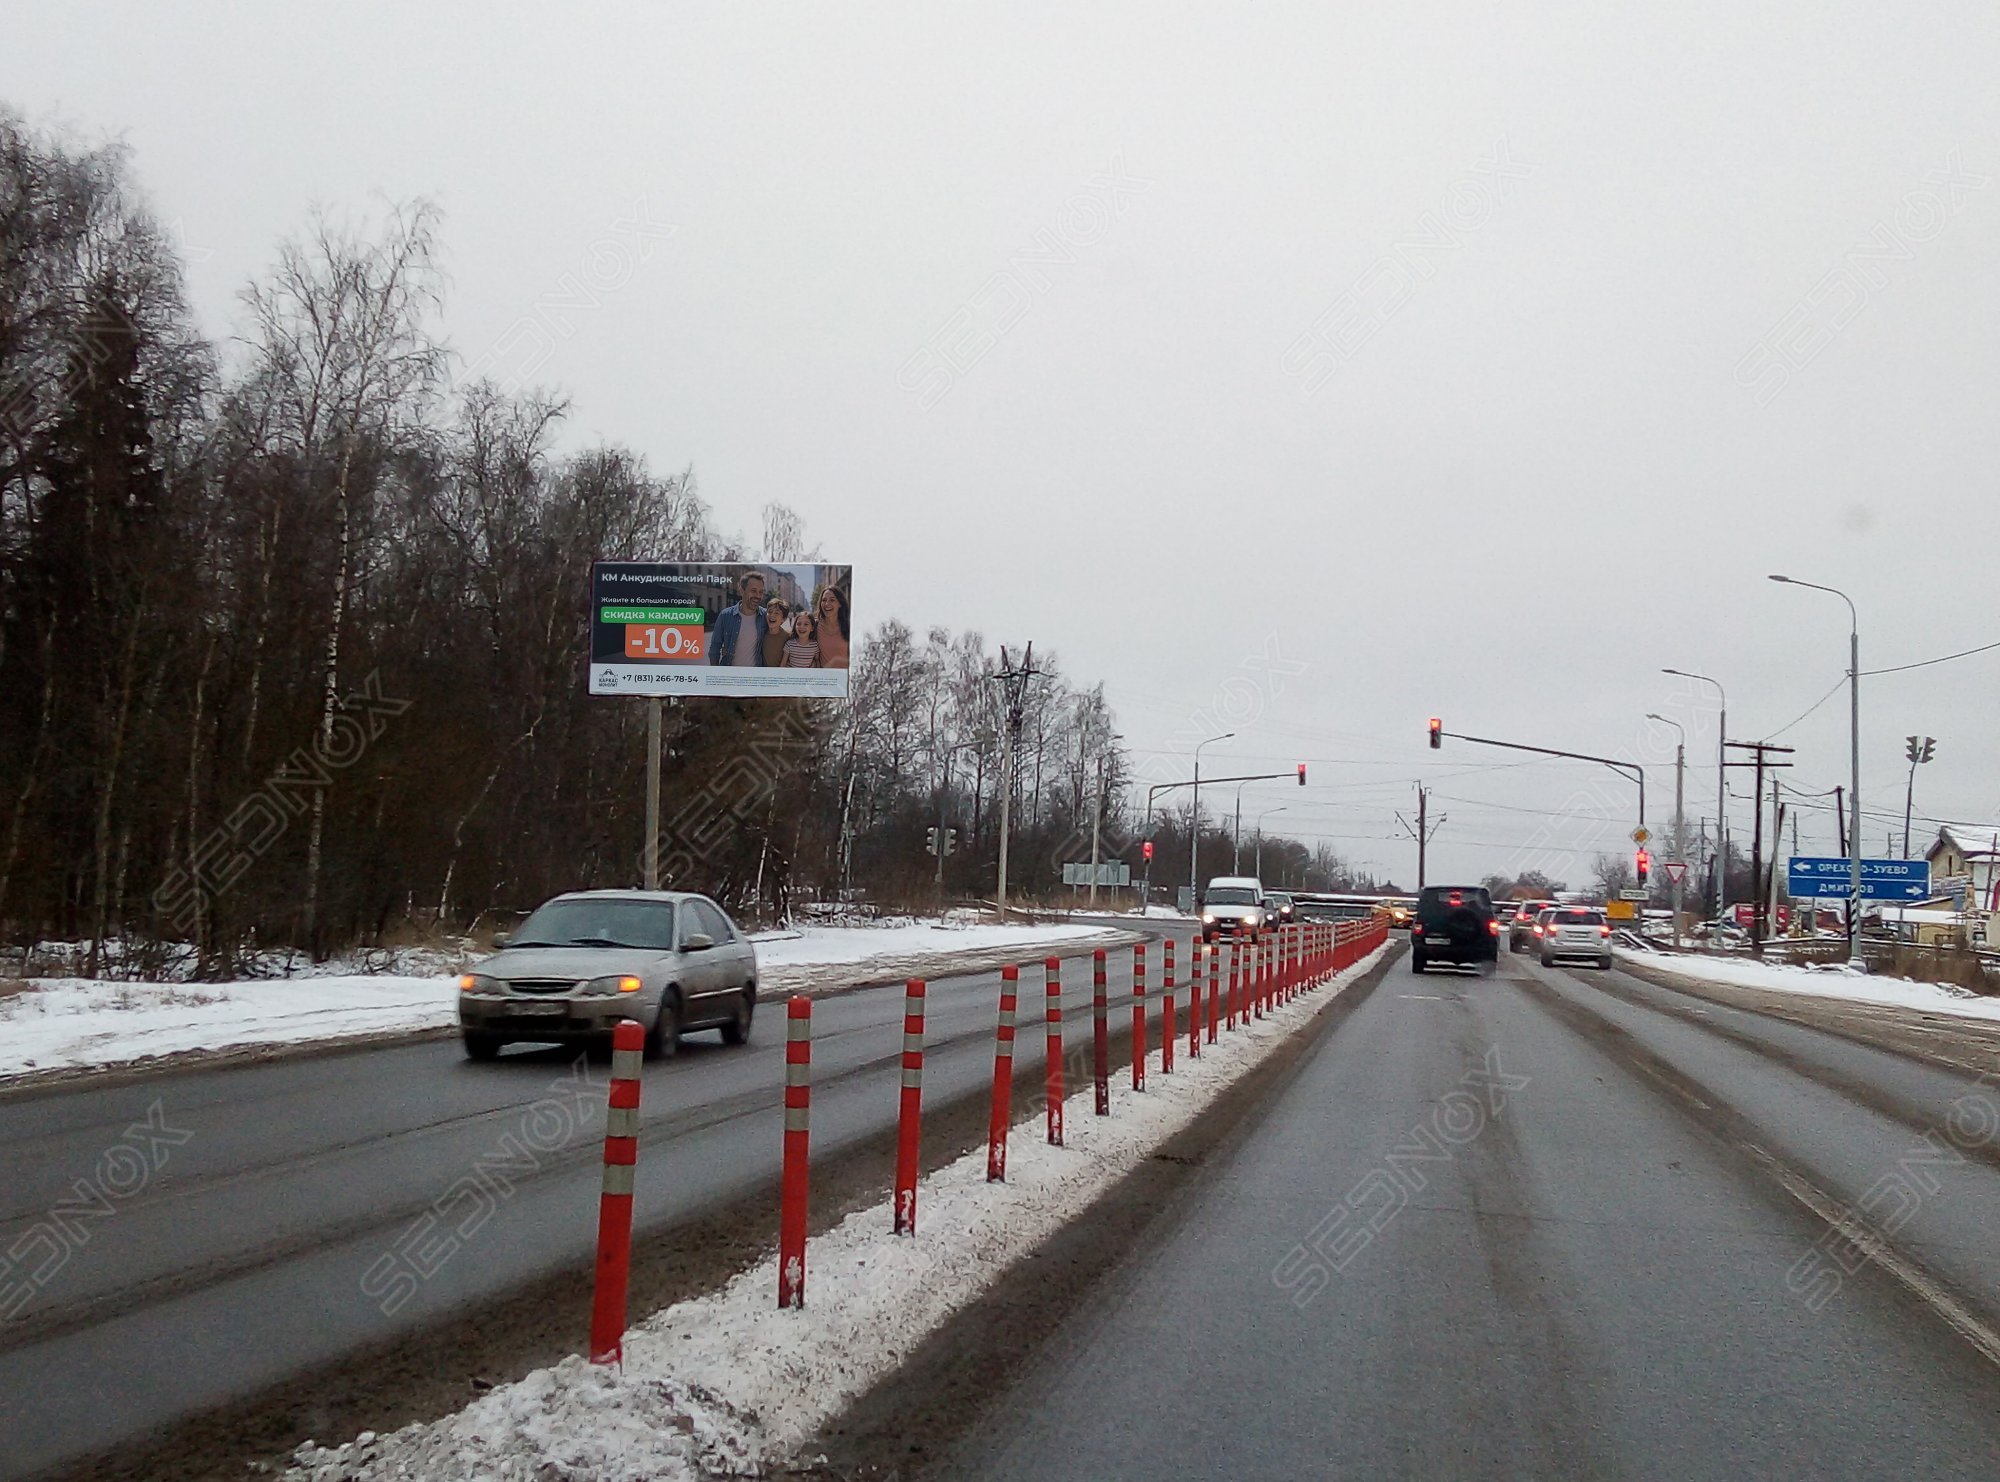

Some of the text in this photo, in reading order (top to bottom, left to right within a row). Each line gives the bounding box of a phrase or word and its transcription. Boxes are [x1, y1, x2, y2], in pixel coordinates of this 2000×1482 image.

[602, 573, 733, 584] КМ Анкудиновский Парк
[603, 610, 701, 622] скидка каждому
[631, 627, 700, 654] -10%
[622, 674, 632, 682] +7
[634, 675, 653, 683] (831)
[655, 675, 699, 683] 266-78-54
[1818, 863, 1909, 875] ОРЕХОО-ЗУЕВО
[1818, 883, 1874, 894] ДМИТОВ
